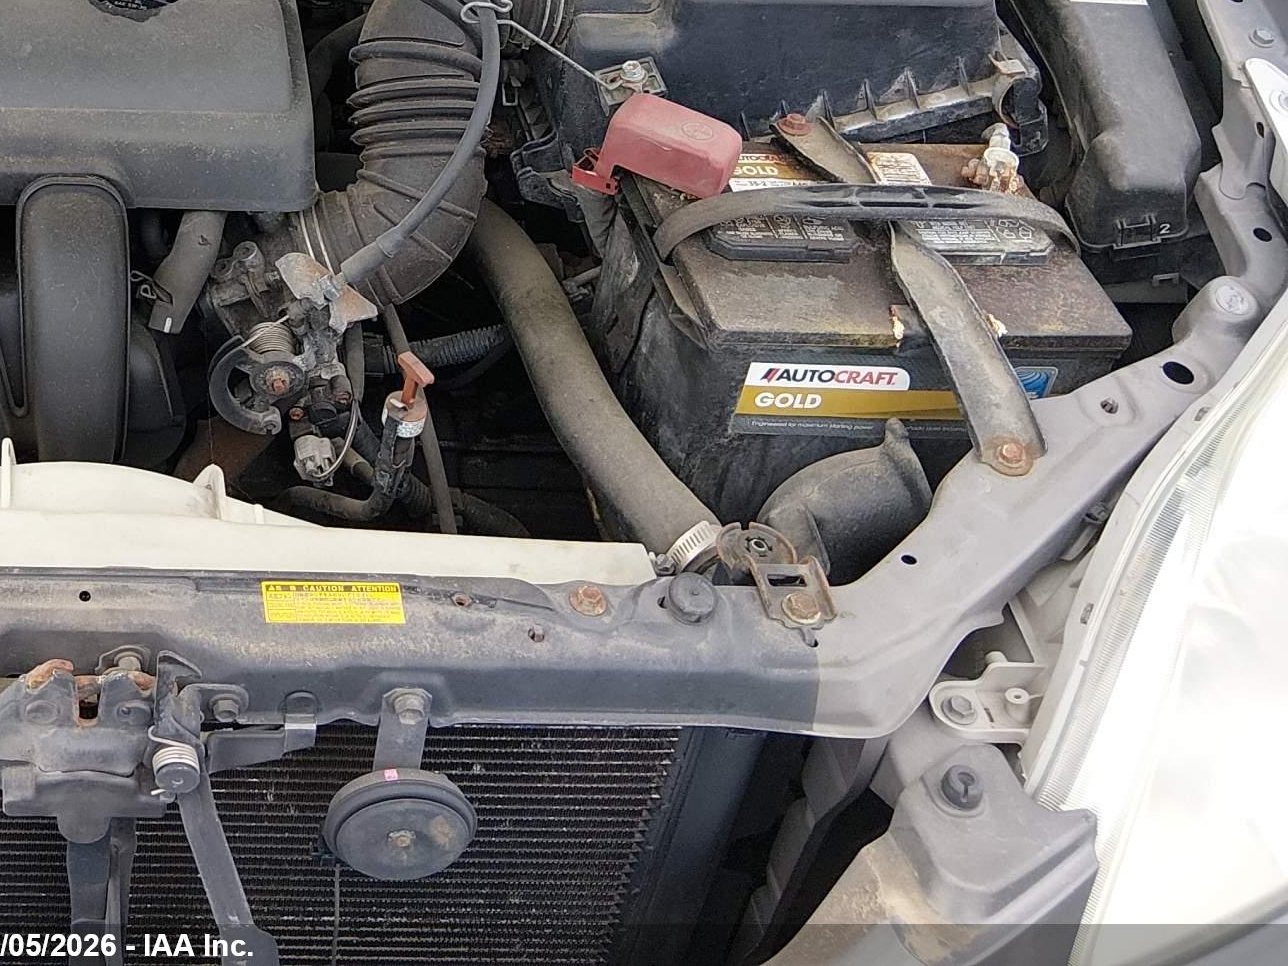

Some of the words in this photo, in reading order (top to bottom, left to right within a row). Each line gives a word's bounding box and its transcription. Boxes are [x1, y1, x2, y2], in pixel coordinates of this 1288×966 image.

[1159, 223, 1171, 234] 2
[775, 368, 898, 386] AUTOCRAFT
[754, 392, 823, 410] GOLD
